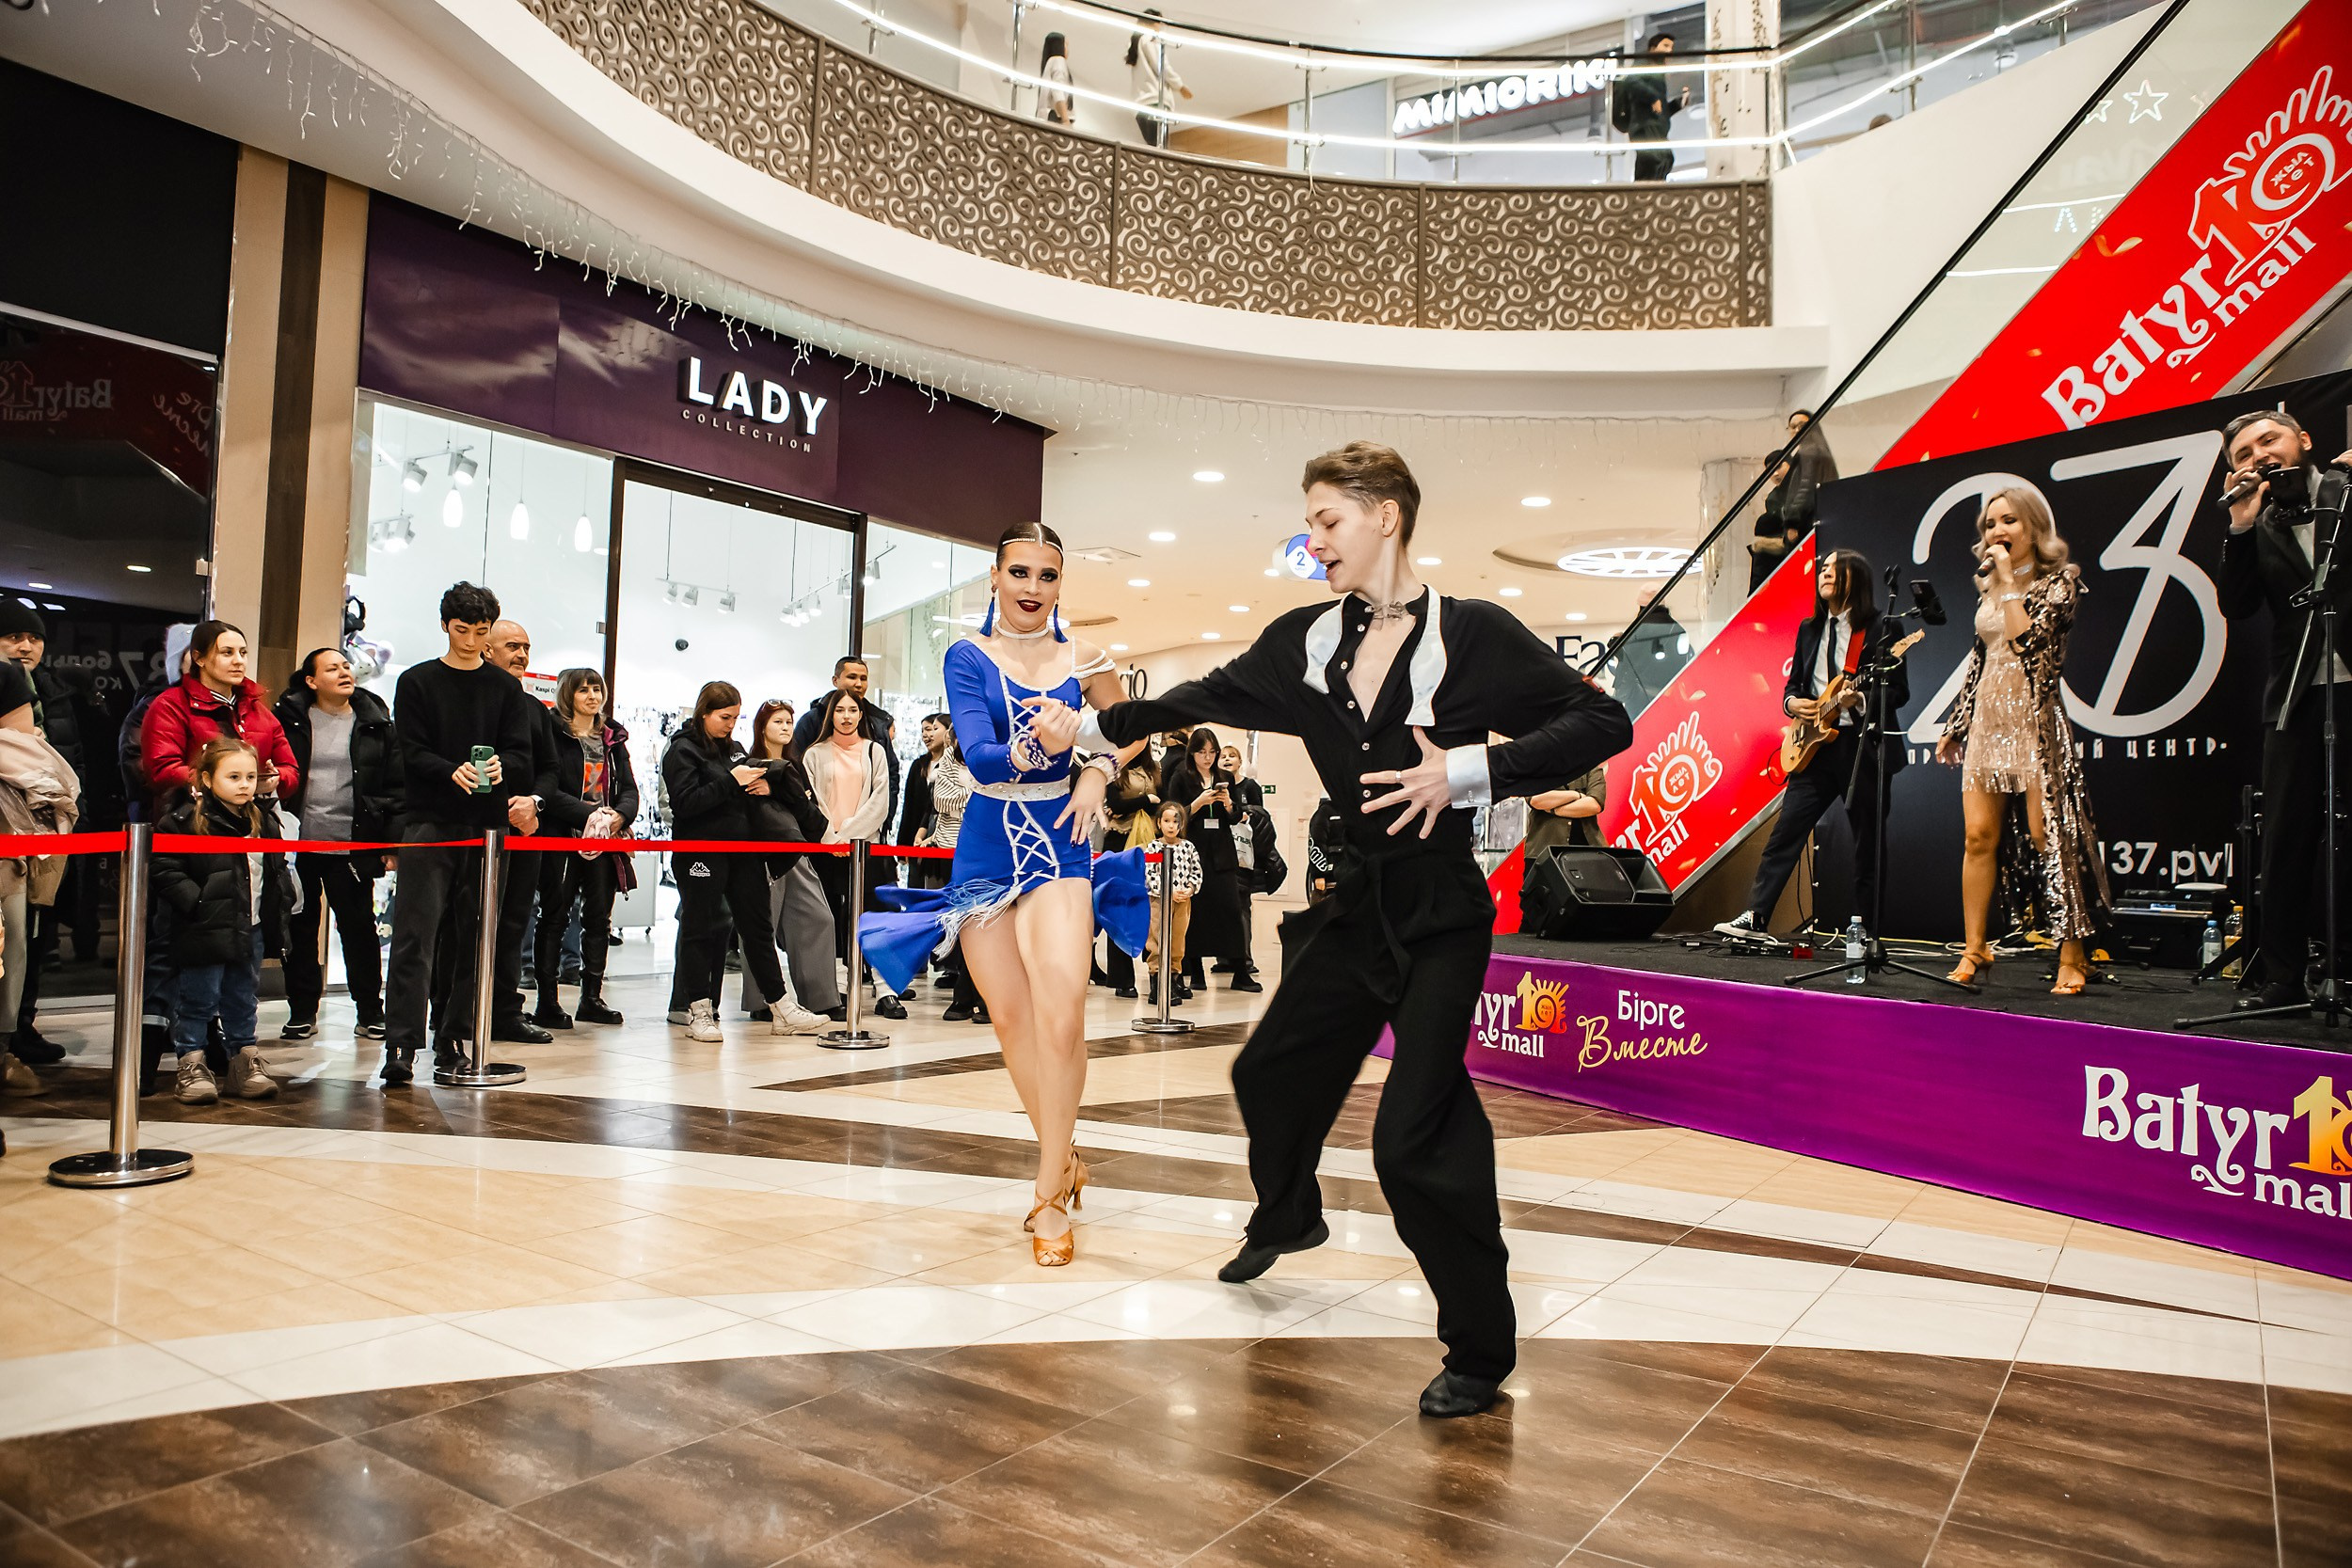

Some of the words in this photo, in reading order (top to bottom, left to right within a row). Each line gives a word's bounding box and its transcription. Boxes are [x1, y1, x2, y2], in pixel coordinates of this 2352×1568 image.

[2212, 227, 2317, 328] mall
[2041, 253, 2221, 430] Batyr
[687, 356, 828, 436] LADY
[682, 408, 811, 452] COLLECTION
[1296, 551, 1306, 566] 2
[1907, 430, 2228, 744] 23
[535, 686, 550, 694] Kaspi
[1617, 989, 1686, 1030] Бірге
[1501, 1033, 1544, 1057] mall
[1576, 1015, 1708, 1073] Вместе
[2082, 1065, 2290, 1196] Batyr
[2253, 1173, 2352, 1220] mal
